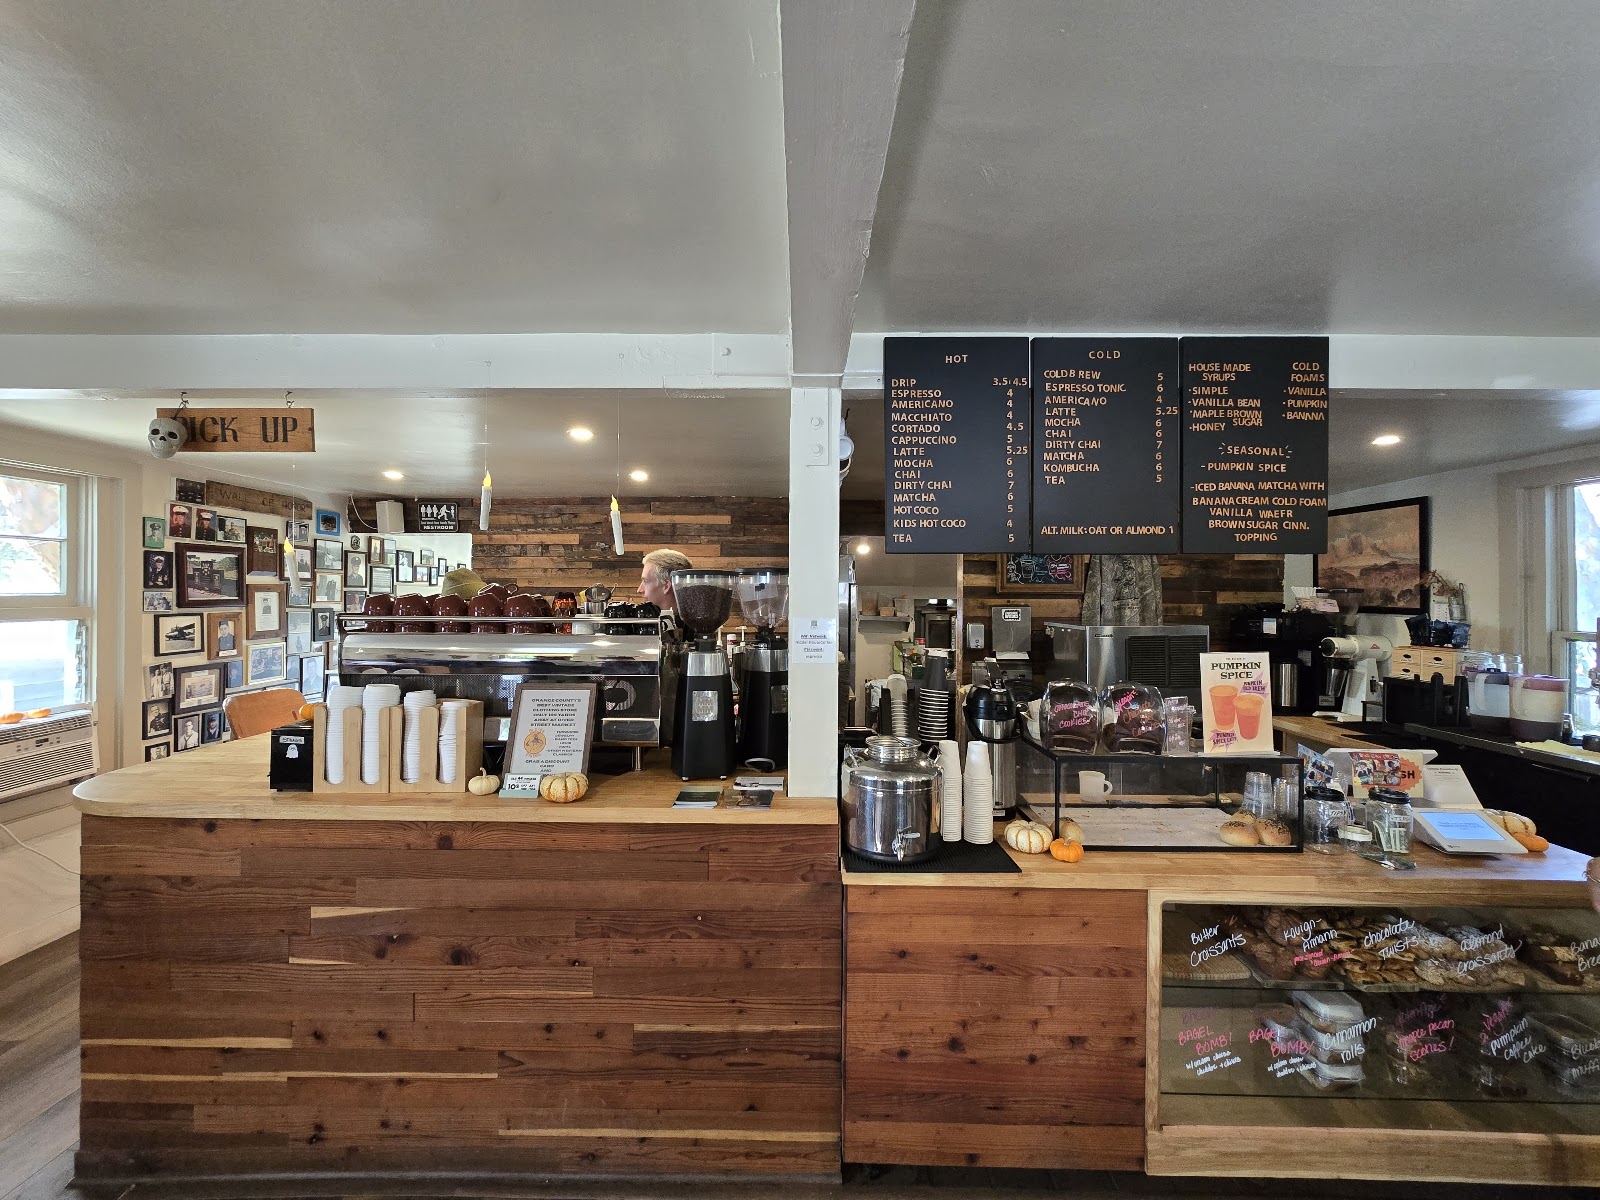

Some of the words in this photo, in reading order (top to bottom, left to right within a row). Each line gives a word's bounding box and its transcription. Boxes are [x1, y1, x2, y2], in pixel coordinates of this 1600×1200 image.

[946, 355, 968, 363] HOT
[1089, 351, 1120, 359] COLD
[1189, 363, 1220, 371] HOUSE
[1203, 373, 1235, 381] SYRUPS
[1291, 374, 1324, 382] FOAMS
[892, 379, 916, 387] DRIP
[1046, 383, 1094, 392] ESPRESSO
[1097, 384, 1126, 392] TONIC
[1157, 384, 1163, 392] 6
[892, 390, 941, 398] ESPRESSO
[1007, 389, 1013, 397] 4
[892, 400, 953, 408] AMERICANO
[1045, 396, 1106, 406] AMERICANO
[892, 413, 952, 421] MACCHIATO
[1007, 411, 1013, 419] 4
[1046, 408, 1076, 416] LATTE
[1156, 407, 1178, 415] 5.25
[1045, 418, 1081, 426] MOCHA
[1233, 418, 1262, 427] SUGAR
[260, 416, 298, 443] UP
[892, 424, 940, 433] CORTADO
[1046, 430, 1071, 438] CHAI
[892, 436, 956, 444] CAPPUCCINO
[1007, 435, 1012, 443] 5
[1046, 441, 1075, 449] DIRTY
[1078, 440, 1100, 448] CHAI
[894, 448, 924, 456] LATTE
[1007, 446, 1027, 454] 5.25
[1227, 446, 1284, 455] SEASONAL
[1044, 452, 1084, 460] MATCHA
[1156, 452, 1161, 460] 6
[895, 459, 933, 467] MOCHA
[1044, 464, 1099, 472] KOMBUCHA
[1156, 463, 1162, 471] 6
[1259, 464, 1286, 472] SPICE
[895, 470, 920, 479] CHAI
[1045, 476, 1065, 484] TEA
[895, 481, 925, 489] DIRTY
[928, 481, 951, 489] CHAI
[1008, 481, 1014, 489] 7
[1218, 482, 1255, 490] BANANA
[1258, 482, 1297, 490] MATCHA
[1299, 482, 1324, 490] WITH
[219, 489, 249, 503] WALL
[894, 493, 936, 502] MATCHA
[1008, 492, 1013, 500] 6
[1193, 497, 1235, 505] BANANA
[1236, 497, 1269, 505] CREAM
[1272, 497, 1297, 505] COLD
[1300, 498, 1326, 506] FOAM
[894, 506, 912, 514] HOT
[914, 506, 939, 515] COCO
[1210, 508, 1253, 517] VANILLA
[894, 519, 916, 527] KIDS
[1209, 520, 1245, 528] BROWN
[1247, 521, 1278, 529] SUGAR
[1283, 521, 1309, 529] CINN.
[1041, 526, 1058, 534] ALT.
[1089, 526, 1107, 534] OAT
[1126, 526, 1165, 534] ALMOND
[893, 534, 912, 542] TEA
[1009, 534, 1014, 542] 5
[1234, 533, 1277, 541] TOPPING
[1211, 662, 1261, 670] PUMPKIN
[1191, 924, 1219, 945] Butter
[1364, 918, 1415, 947] chocolate
[1461, 923, 1504, 951] almond
[1191, 934, 1246, 966] Croissants
[1378, 936, 1419, 960] Twists
[1428, 1020, 1454, 1036] pecan
[1178, 1026, 1214, 1046] BAGEL
[1490, 1018, 1528, 1056] pumpkin
[1195, 1032, 1232, 1056] BOMB!
[1504, 1036, 1532, 1060] coffee
[1341, 1043, 1365, 1063] rolls
[1523, 1044, 1546, 1063] cake
